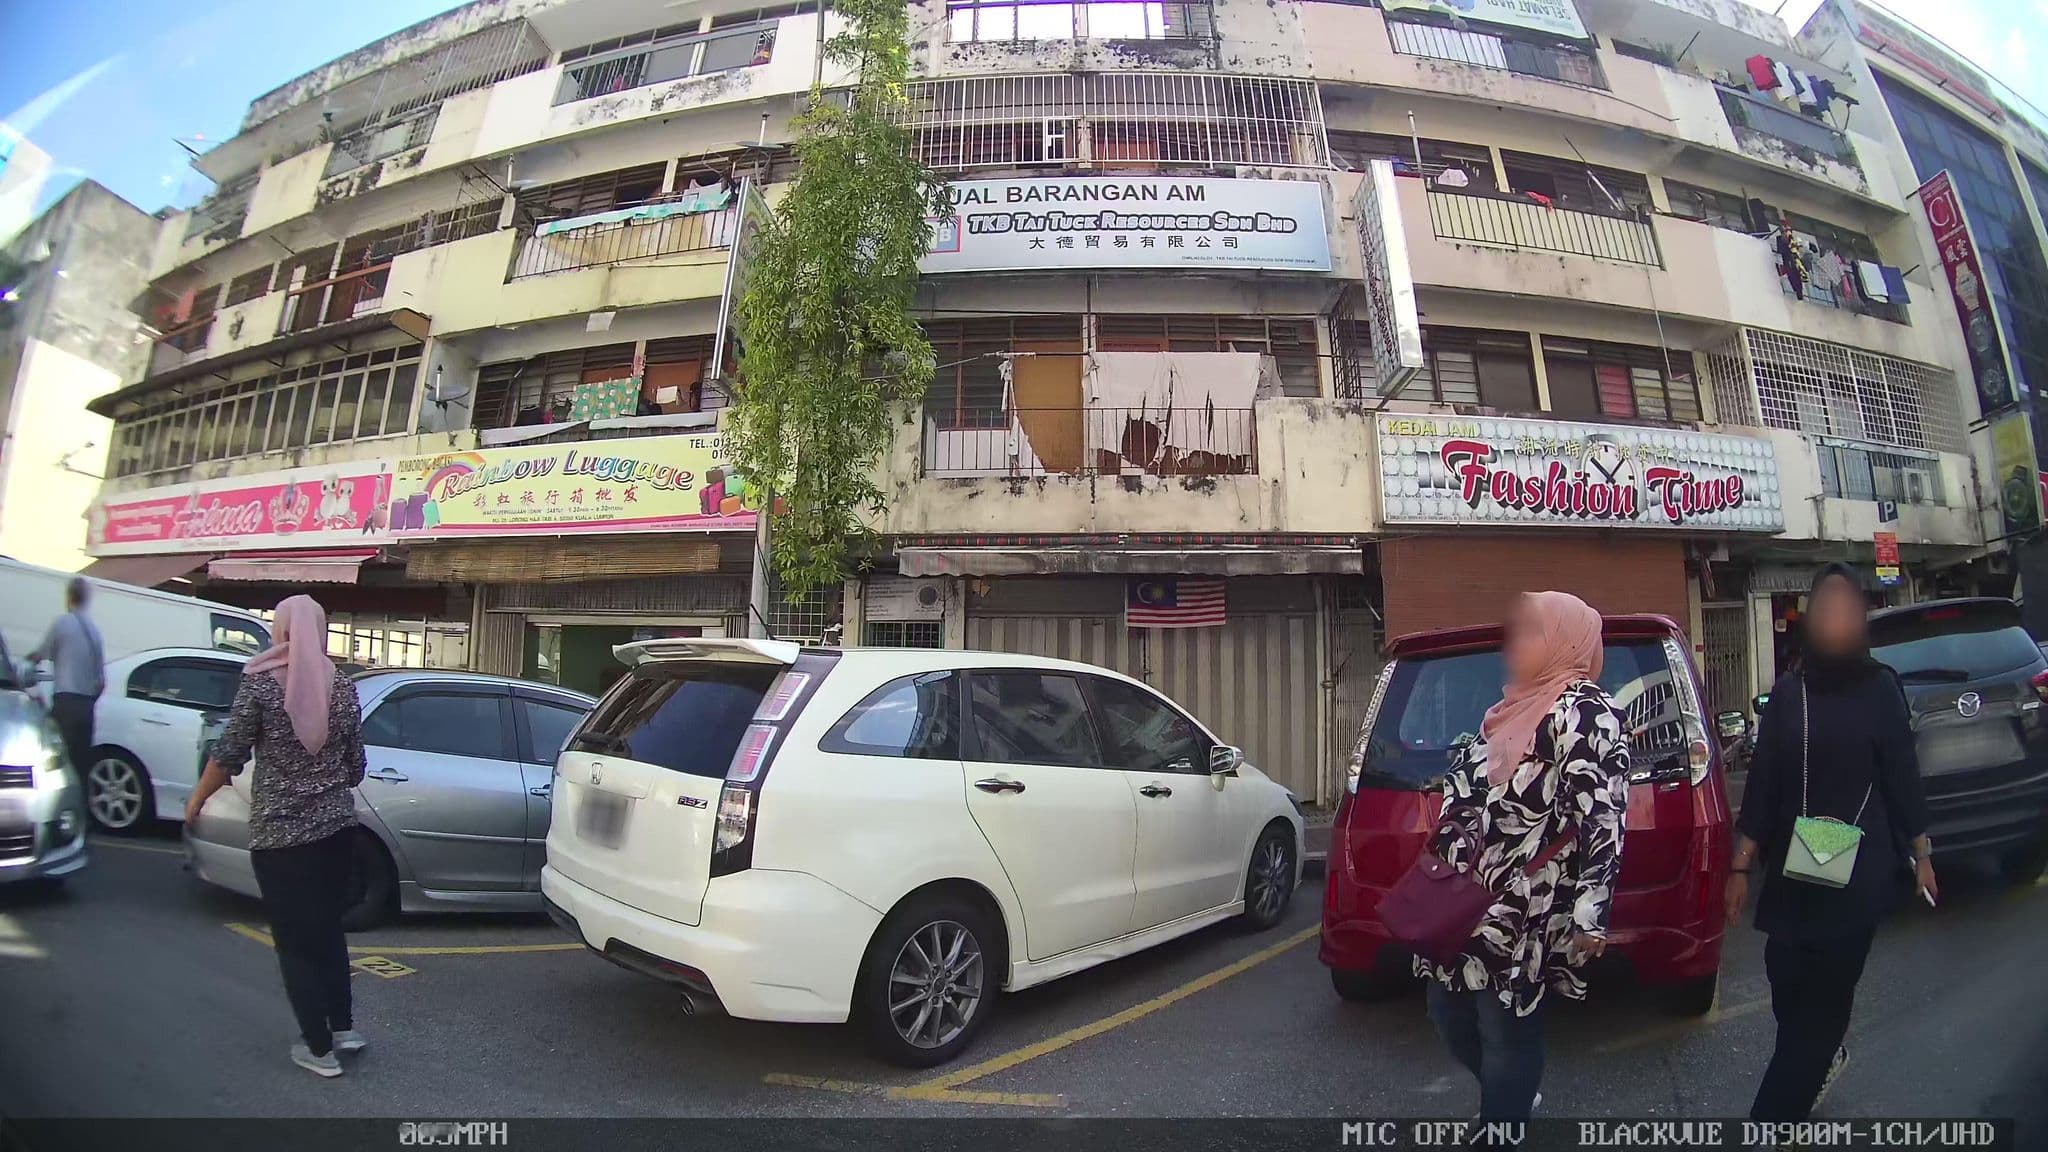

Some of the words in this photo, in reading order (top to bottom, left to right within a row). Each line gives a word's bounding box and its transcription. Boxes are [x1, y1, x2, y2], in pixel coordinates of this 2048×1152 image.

[1006, 184, 1158, 203] BARANGAN
[1166, 184, 1206, 202] AM
[1929, 190, 1959, 228] CJ
[968, 214, 1013, 234] TKB
[1015, 212, 1045, 232] TAI
[1050, 211, 1098, 231] TUCK
[1100, 211, 1211, 230] RESOURCES
[1028, 235, 1239, 249] 大德貿易有限公司
[1387, 420, 1439, 436] KEDAI
[1441, 422, 1478, 438] JAM
[440, 455, 558, 503] Rainbow
[563, 449, 695, 491] Luggage
[1440, 439, 1638, 518] Fashion
[1645, 465, 1743, 524] Time
[472, 485, 639, 508] 彩虹旅行箱批发
[1884, 501, 1895, 521] P
